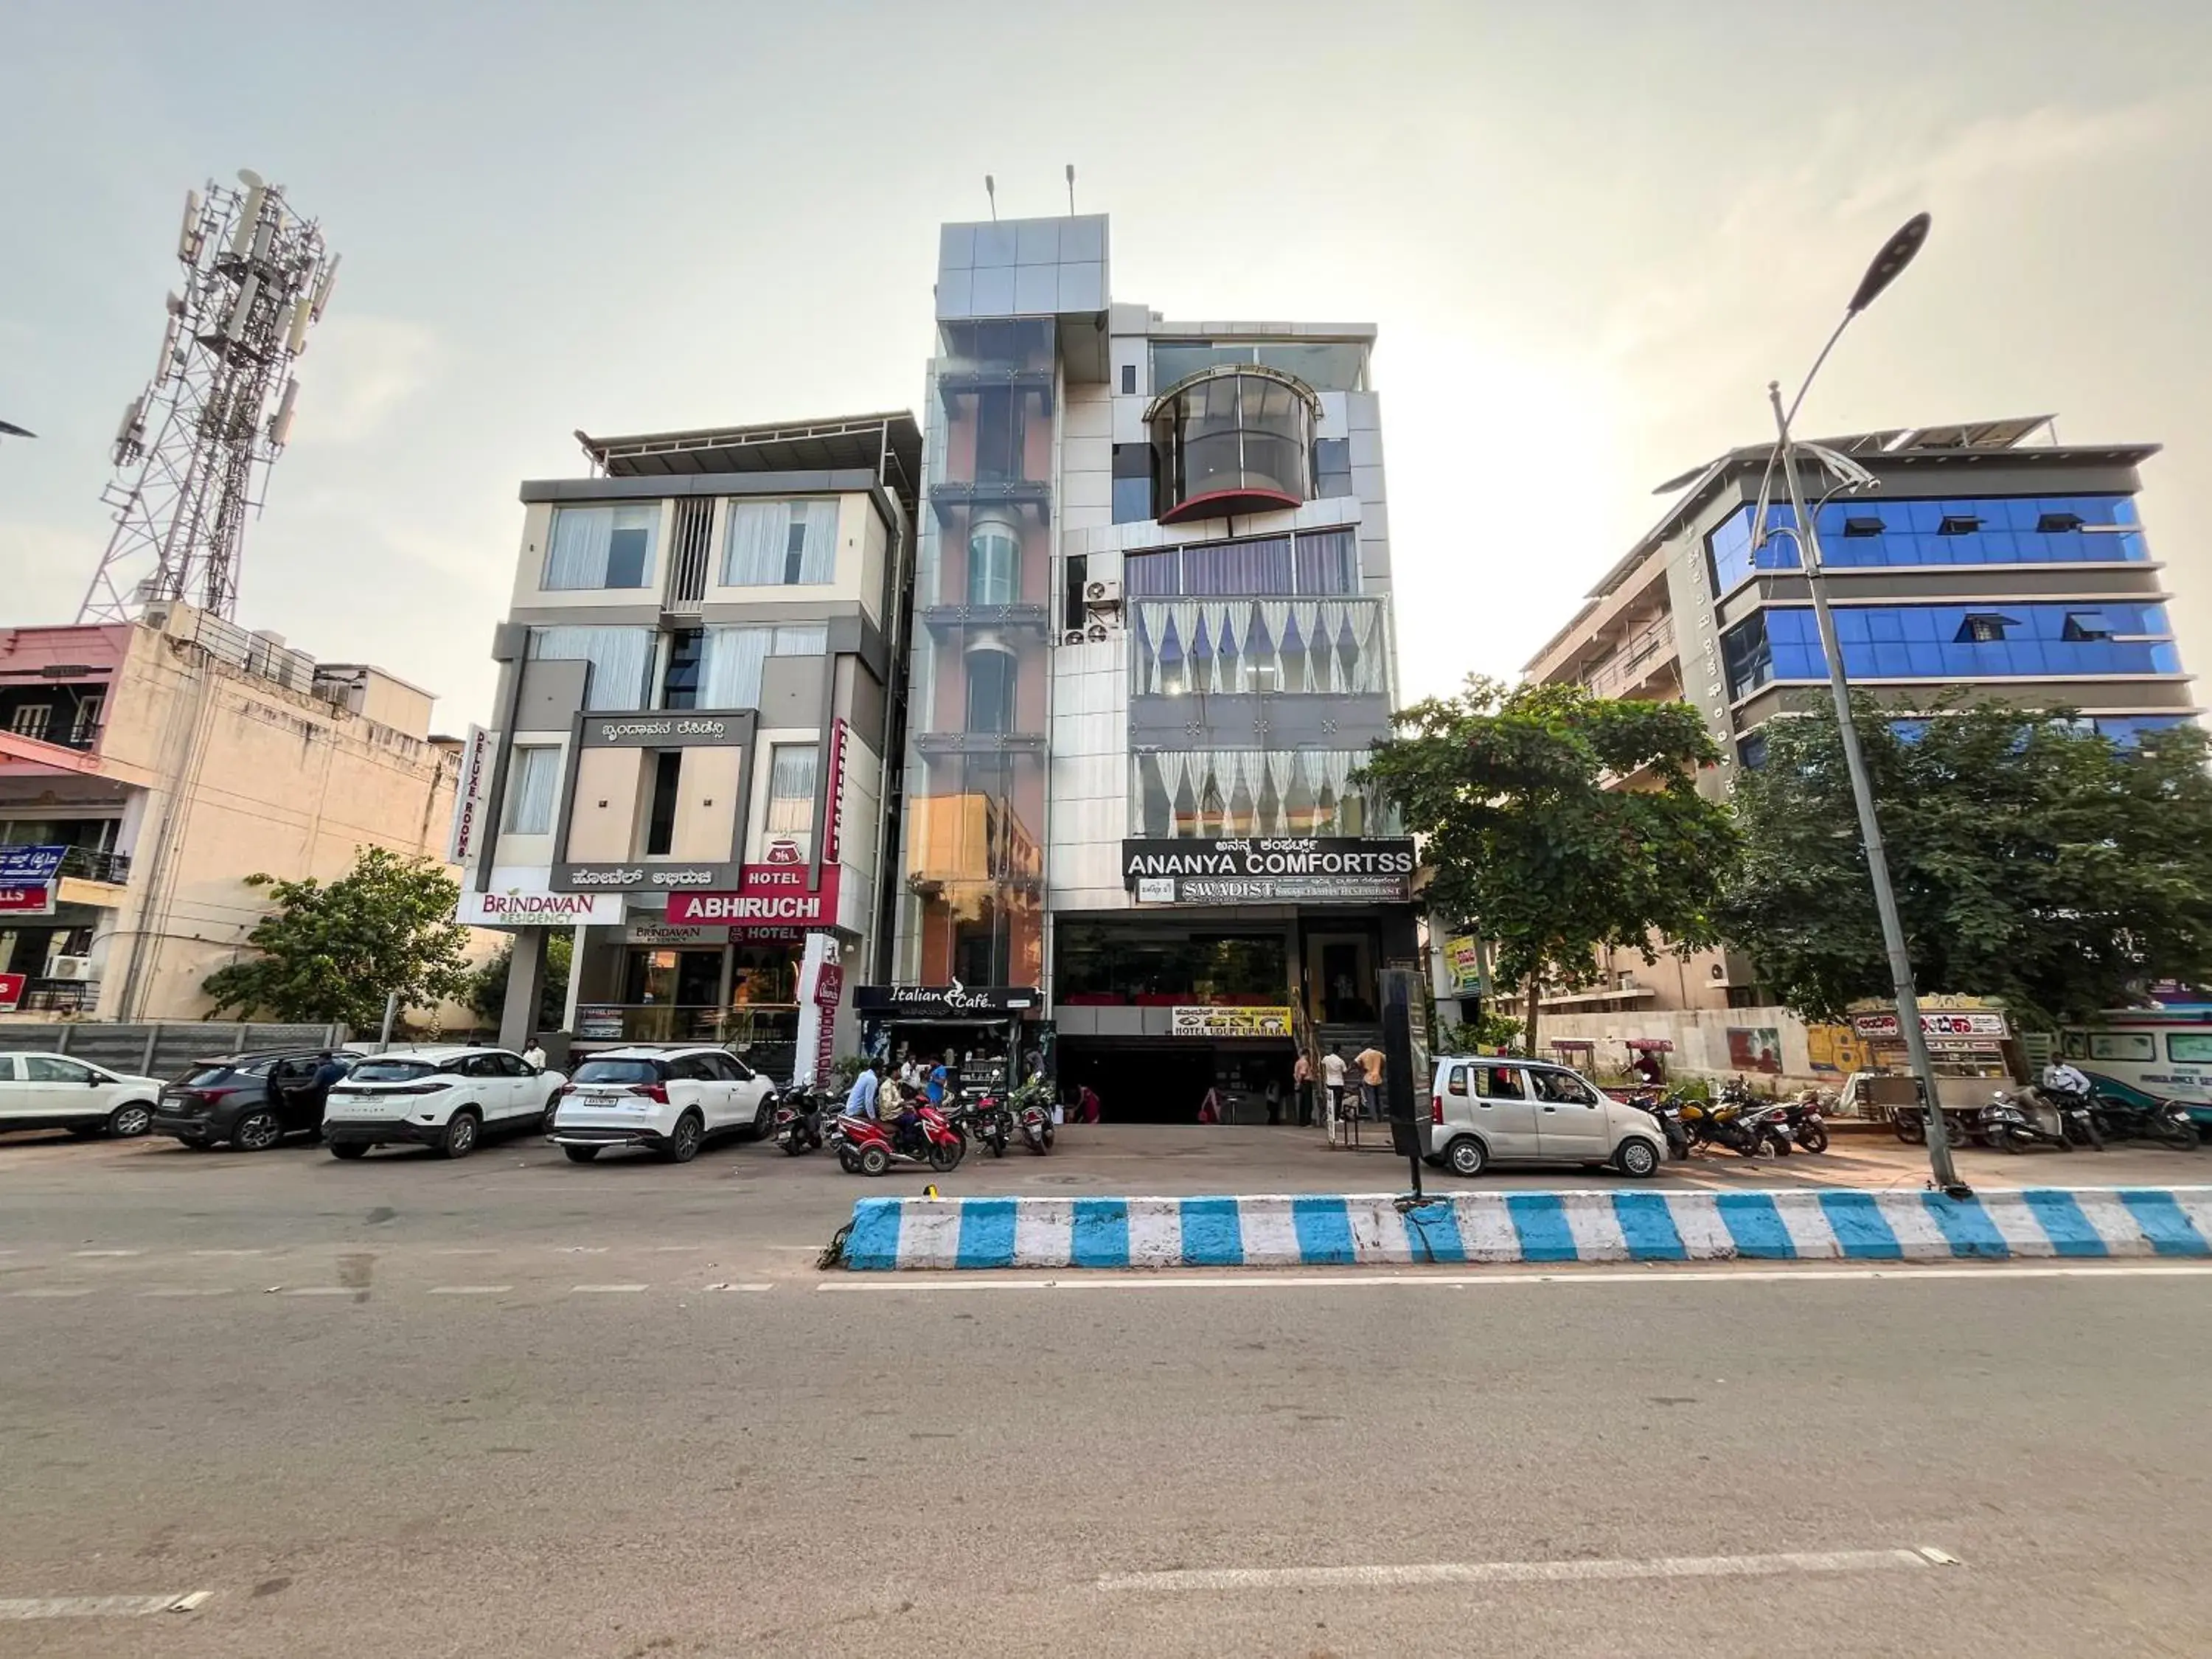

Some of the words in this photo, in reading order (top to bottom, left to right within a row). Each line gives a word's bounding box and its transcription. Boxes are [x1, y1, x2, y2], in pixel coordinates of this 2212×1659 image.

[468, 731, 485, 798] DELUXE
[457, 801, 473, 858] ROOMS
[1215, 838, 1252, 856] ಅನನ್ಯ
[1127, 854, 1237, 874] ANANYA
[1245, 852, 1413, 874] COMFORTSS
[748, 872, 801, 885] HOTEL
[1182, 881, 1276, 898] SWADIST
[482, 893, 596, 914] BRINDAVAN
[684, 897, 821, 919] ABHIRUCHI
[499, 912, 574, 924] RESIDENCY
[636, 926, 701, 937] BRINDAVAN
[747, 927, 798, 939] HOTEL
[889, 985, 942, 1001] Italian
[1175, 1027, 1206, 1036] HOTEL
